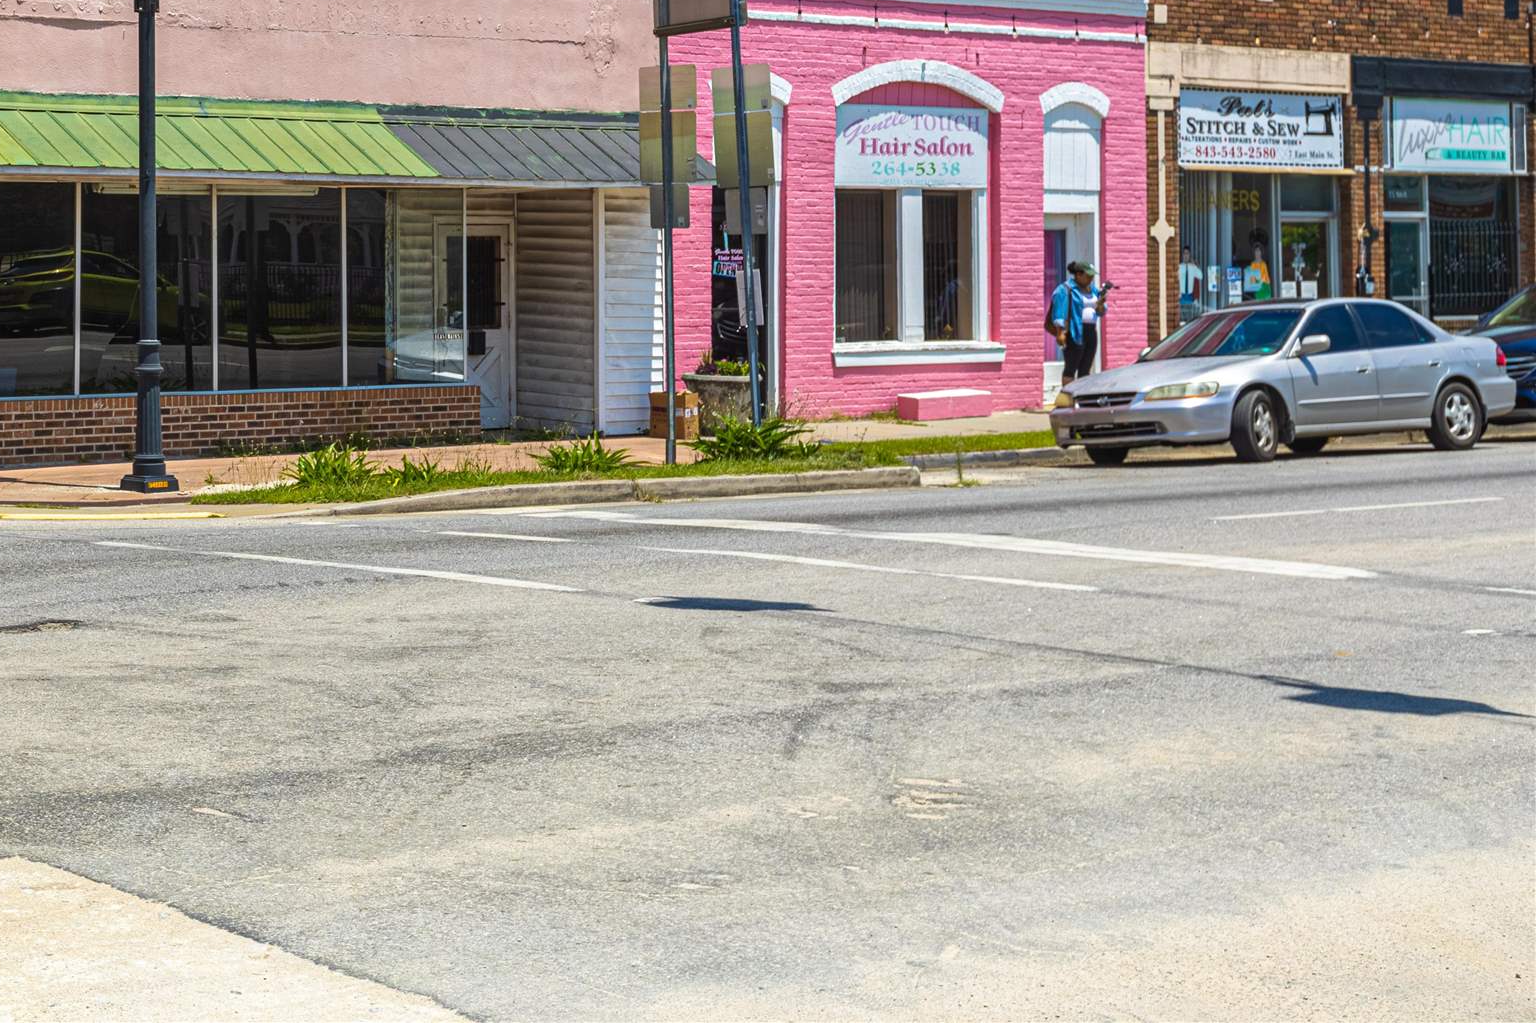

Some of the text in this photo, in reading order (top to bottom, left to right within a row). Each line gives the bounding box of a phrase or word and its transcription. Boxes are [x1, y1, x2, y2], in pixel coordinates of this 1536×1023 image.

[843, 113, 980, 145] Gentle TOUCH
[1186, 117, 1300, 137] STITCH & SEW
[1448, 115, 1506, 144] HAIR
[859, 136, 974, 157] Hair Salon
[1195, 145, 1276, 159] 843-543-2580
[1456, 150, 1488, 160] BEAUTY
[872, 160, 960, 176] 264-5338
